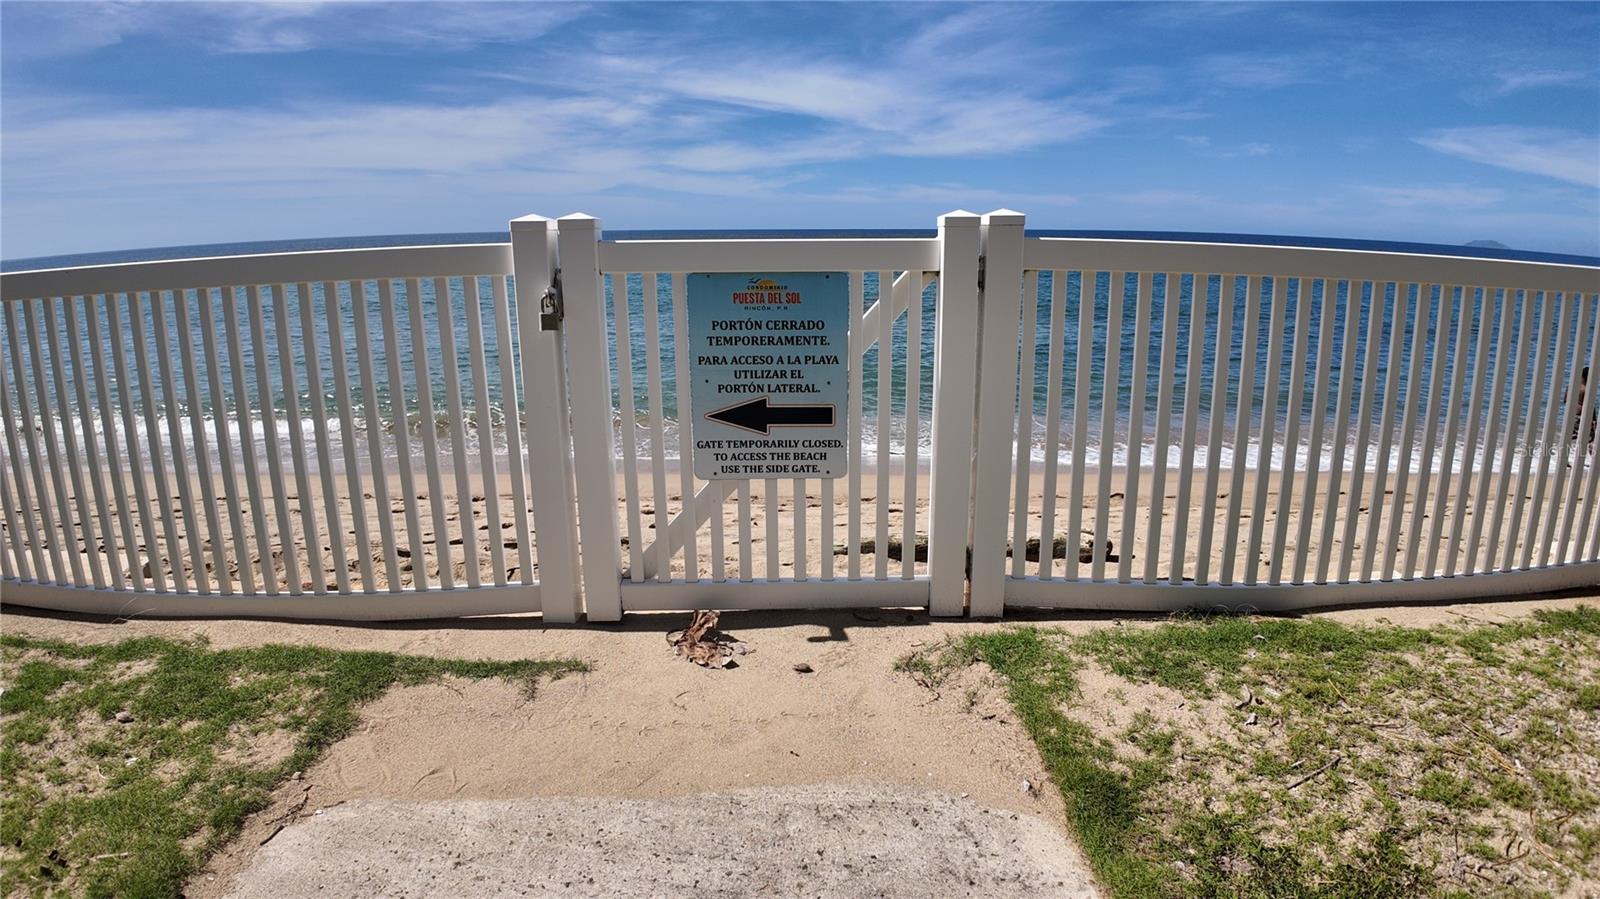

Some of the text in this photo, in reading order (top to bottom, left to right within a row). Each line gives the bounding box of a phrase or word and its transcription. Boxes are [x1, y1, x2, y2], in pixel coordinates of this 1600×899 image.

[733, 292, 802, 304] PUESTA DEL SOL
[711, 318, 825, 330] PORTÓN CERRADO
[706, 335, 830, 346] TEMPORERAMENTE.
[698, 355, 839, 366] PARA ACCESO A LA PLAYA
[734, 369, 804, 379] UTILIZAR EL
[717, 381, 821, 393] PORTÓN LATERAL.
[697, 440, 844, 449] GATE TEMPORARILY CLOSED.
[713, 453, 827, 461] TO ACCESS THE BEACH
[721, 465, 821, 474] USE THE SIDE GATE.
